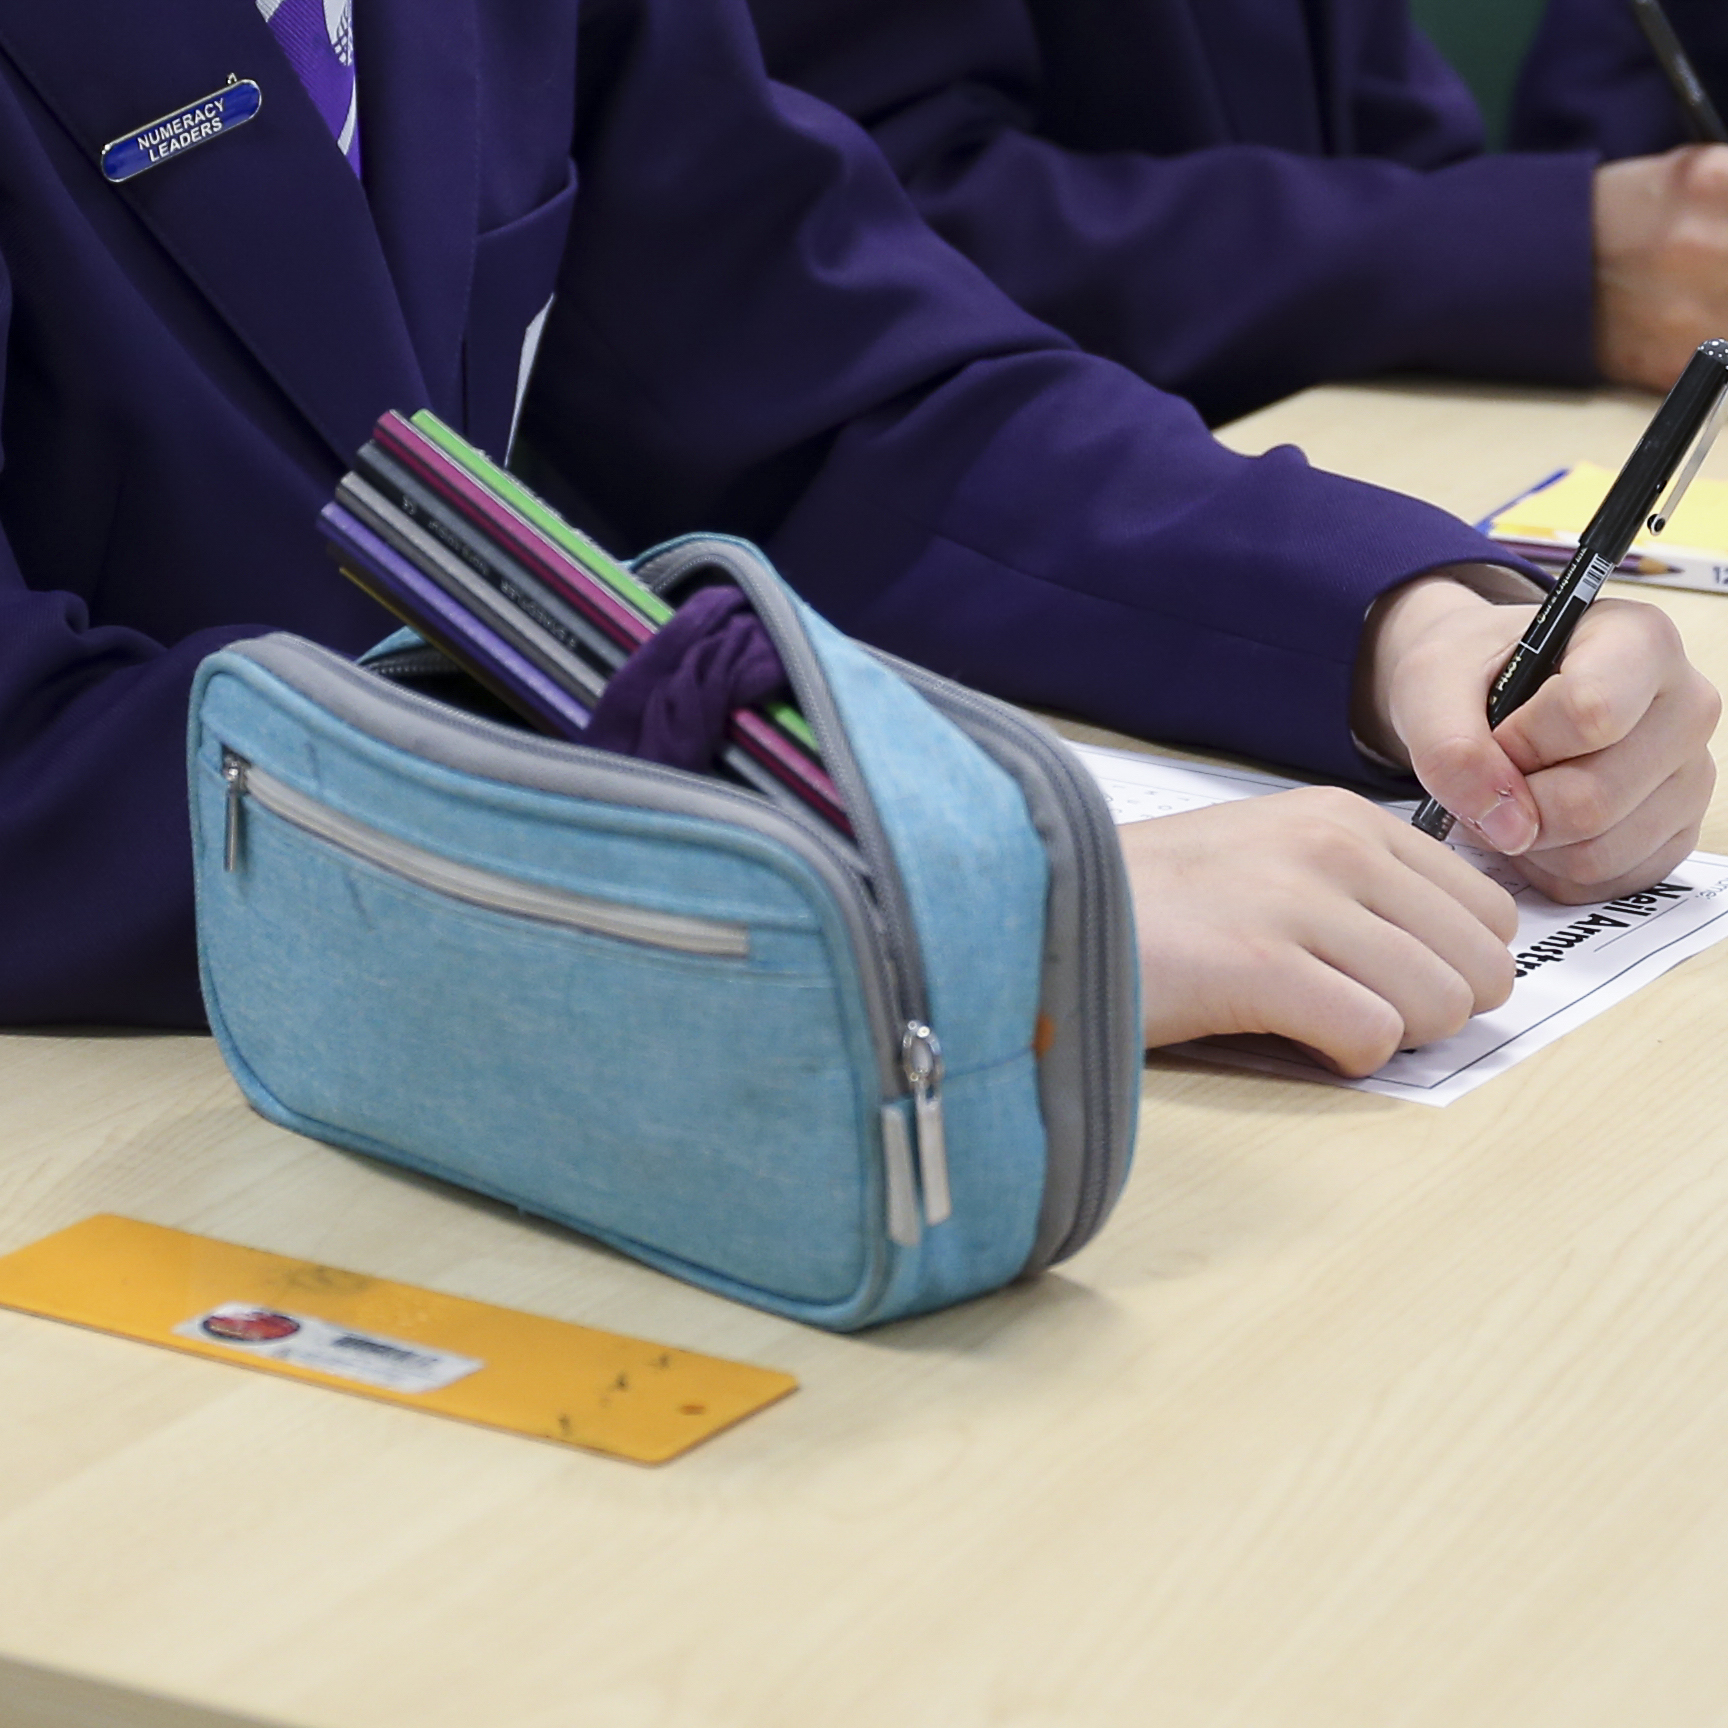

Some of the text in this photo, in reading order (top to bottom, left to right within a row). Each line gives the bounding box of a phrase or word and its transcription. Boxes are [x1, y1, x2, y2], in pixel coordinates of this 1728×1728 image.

[137, 97, 225, 150] NUMERACY
[149, 117, 223, 163] LEADERS
[1496, 655, 1522, 691] PILOT
[1602, 881, 1694, 918] Neil
